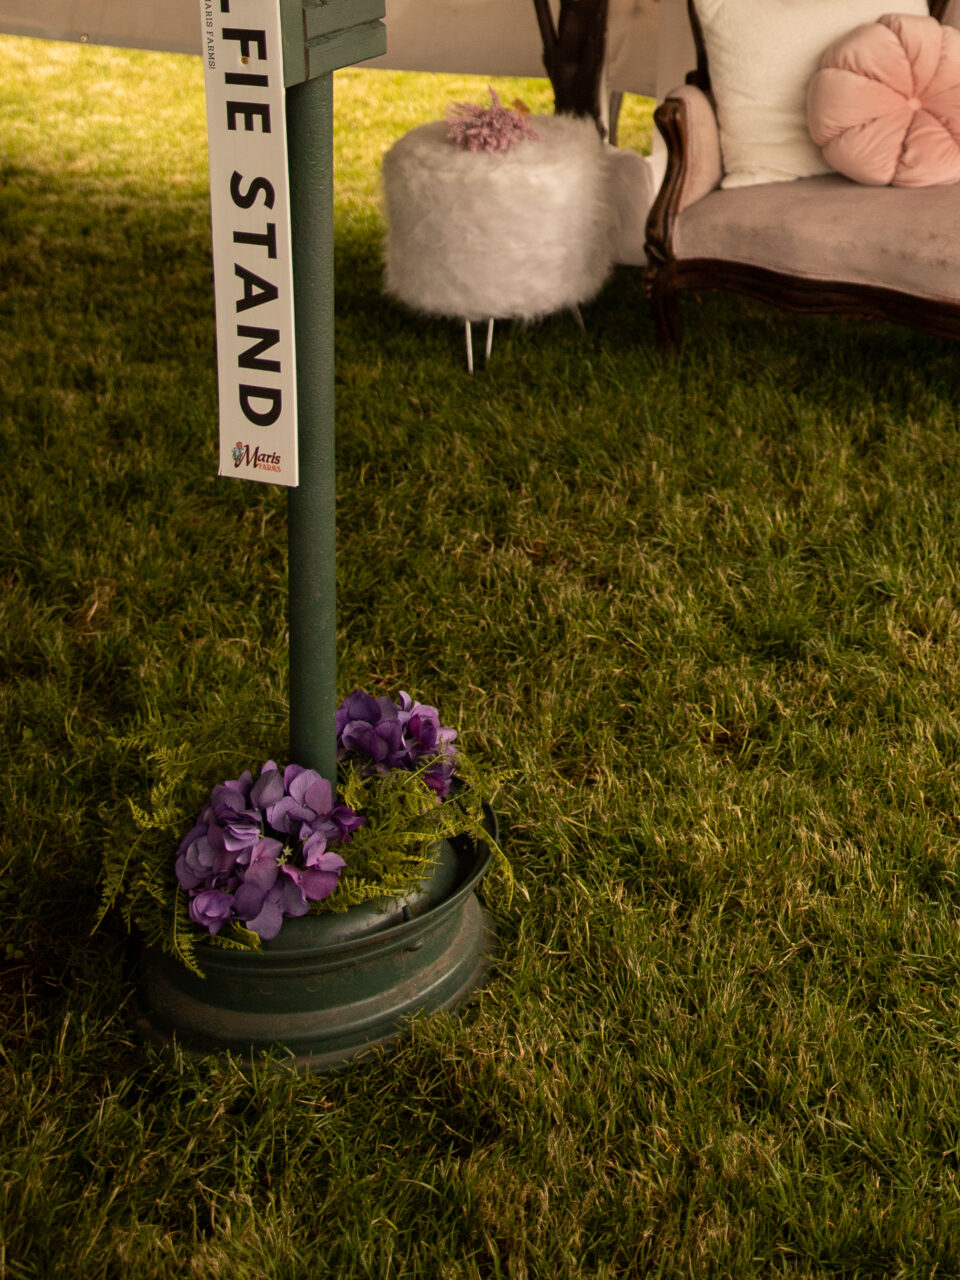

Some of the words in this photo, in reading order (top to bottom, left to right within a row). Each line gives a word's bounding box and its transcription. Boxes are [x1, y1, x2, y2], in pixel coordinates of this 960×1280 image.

[206, 31, 216, 70] FARMS!
[229, 170, 283, 427] STAND
[234, 444, 281, 468] Maris
